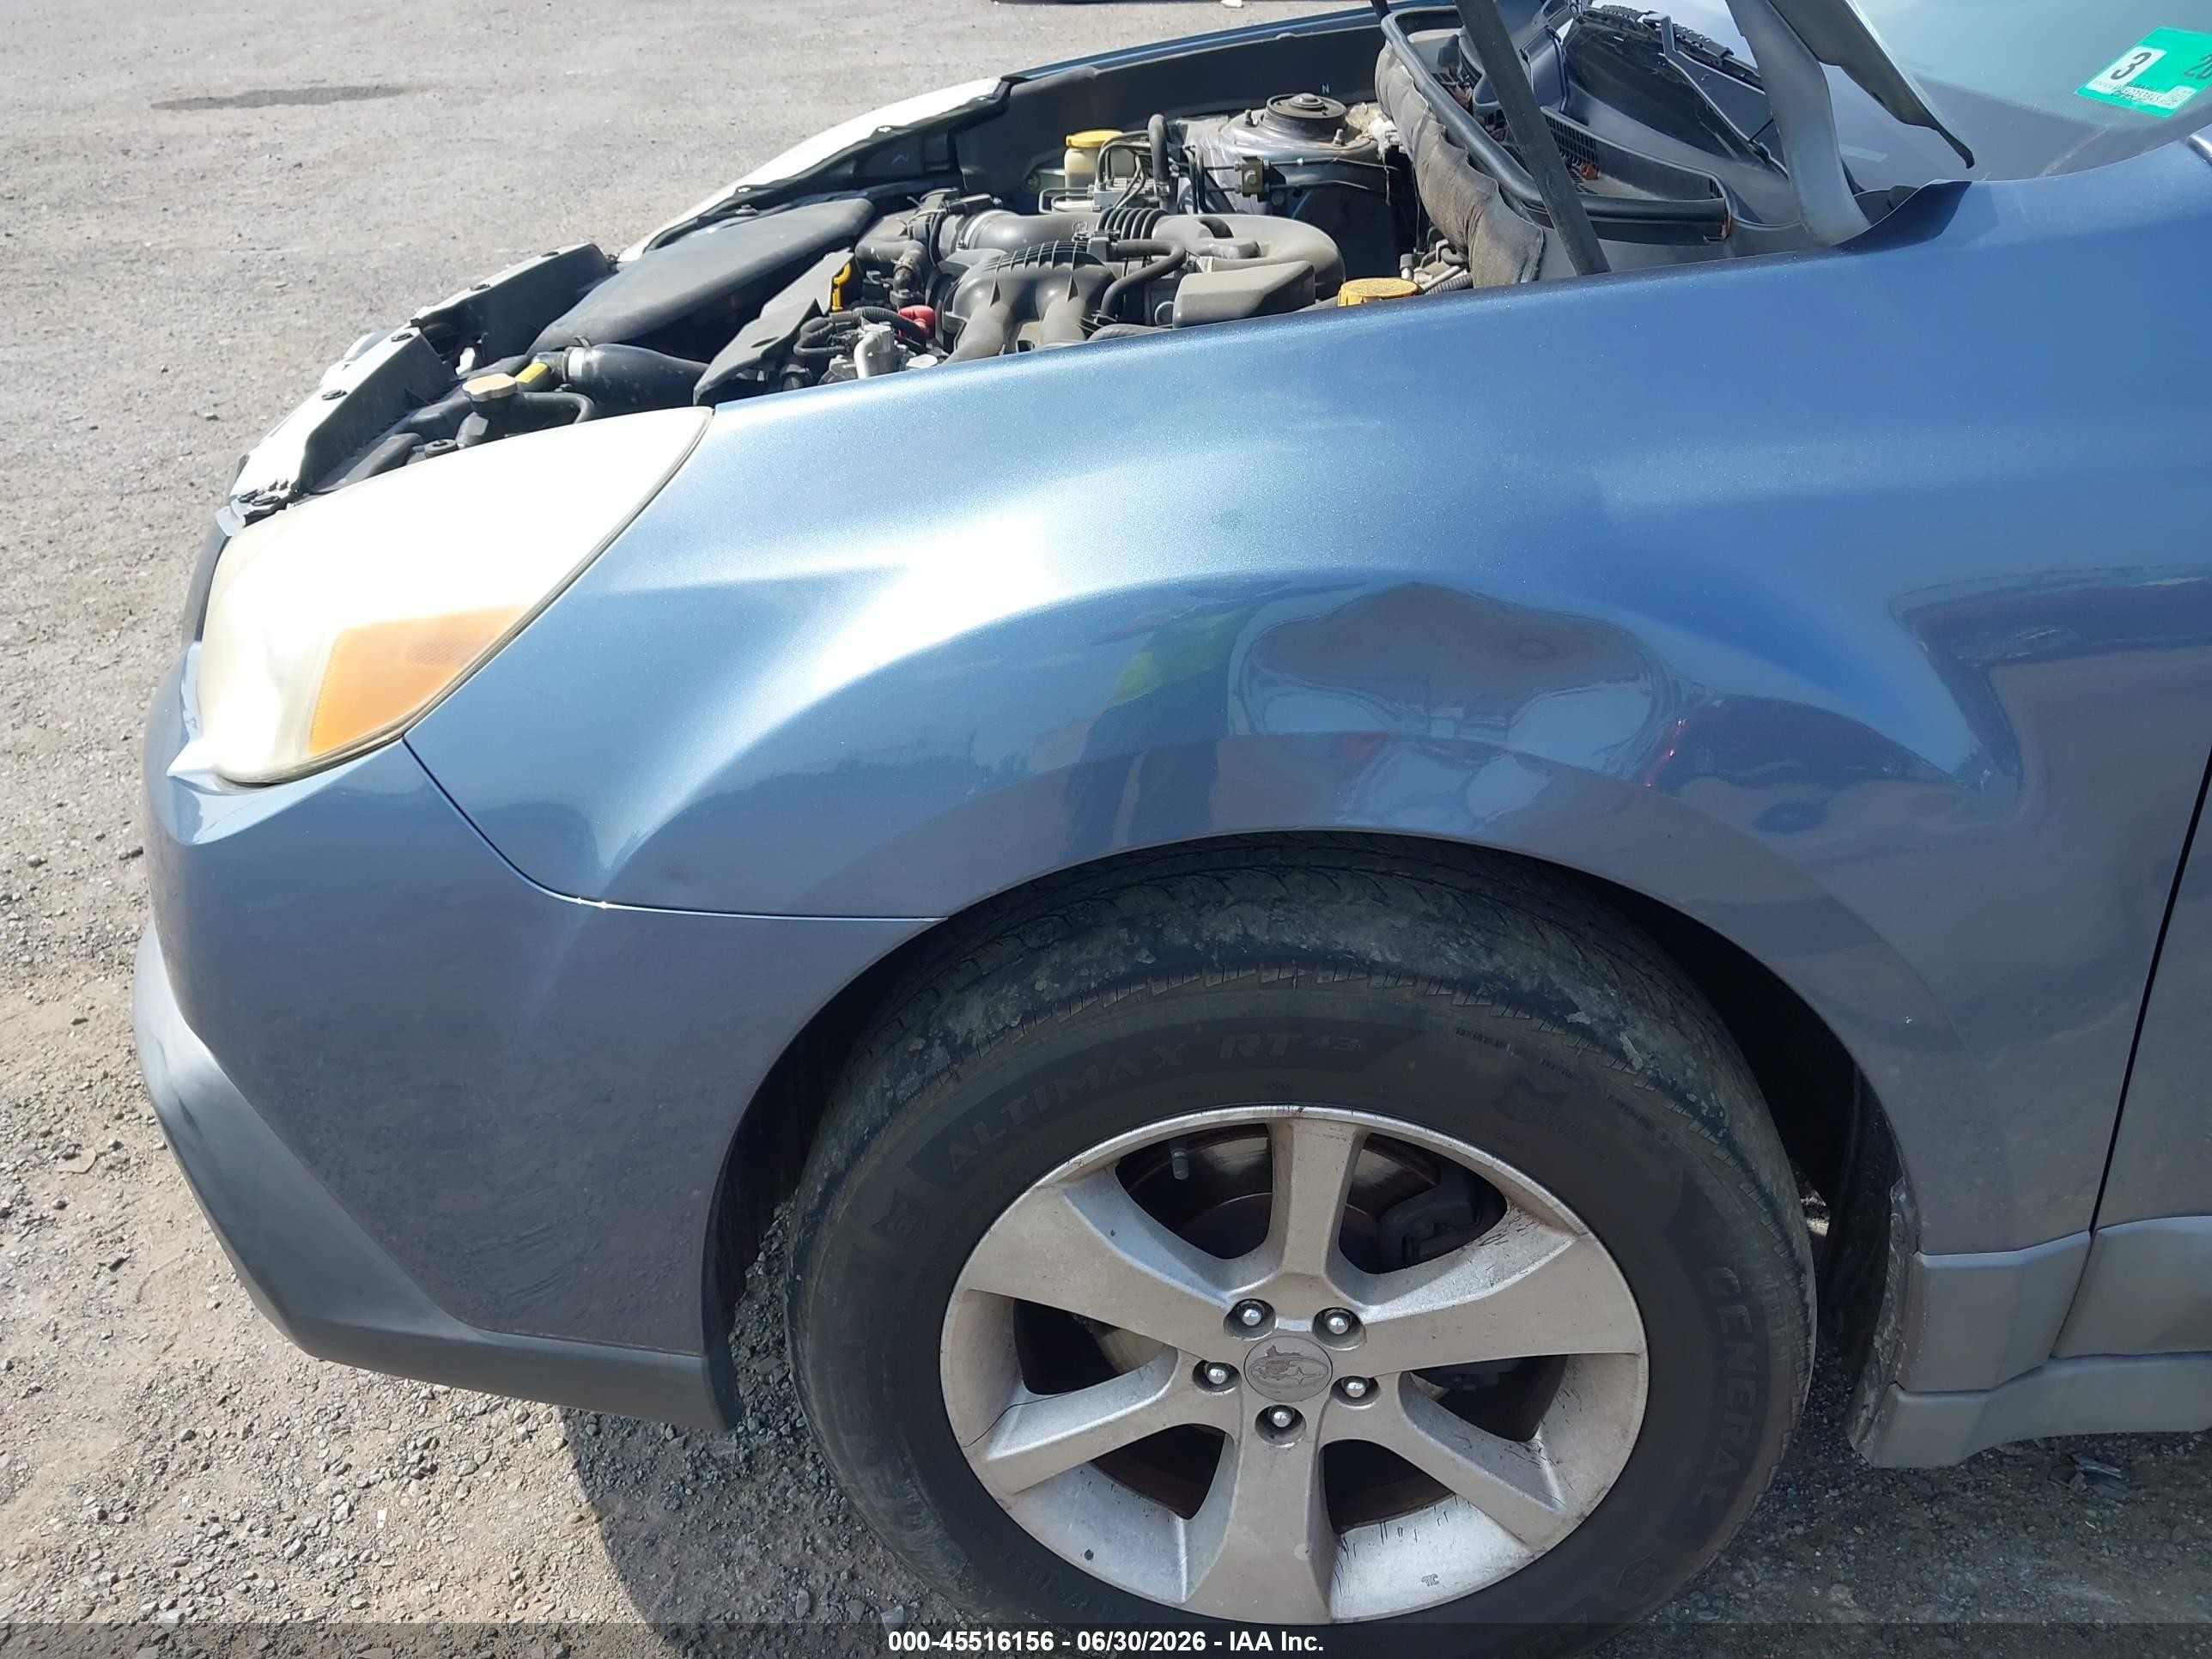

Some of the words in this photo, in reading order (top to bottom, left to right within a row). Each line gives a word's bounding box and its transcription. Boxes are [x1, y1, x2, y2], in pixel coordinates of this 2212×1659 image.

[2110, 52, 2152, 80] 3
[947, 1041, 1188, 1175] ALTIMAX
[1692, 1266, 1757, 1507] GENERAL
